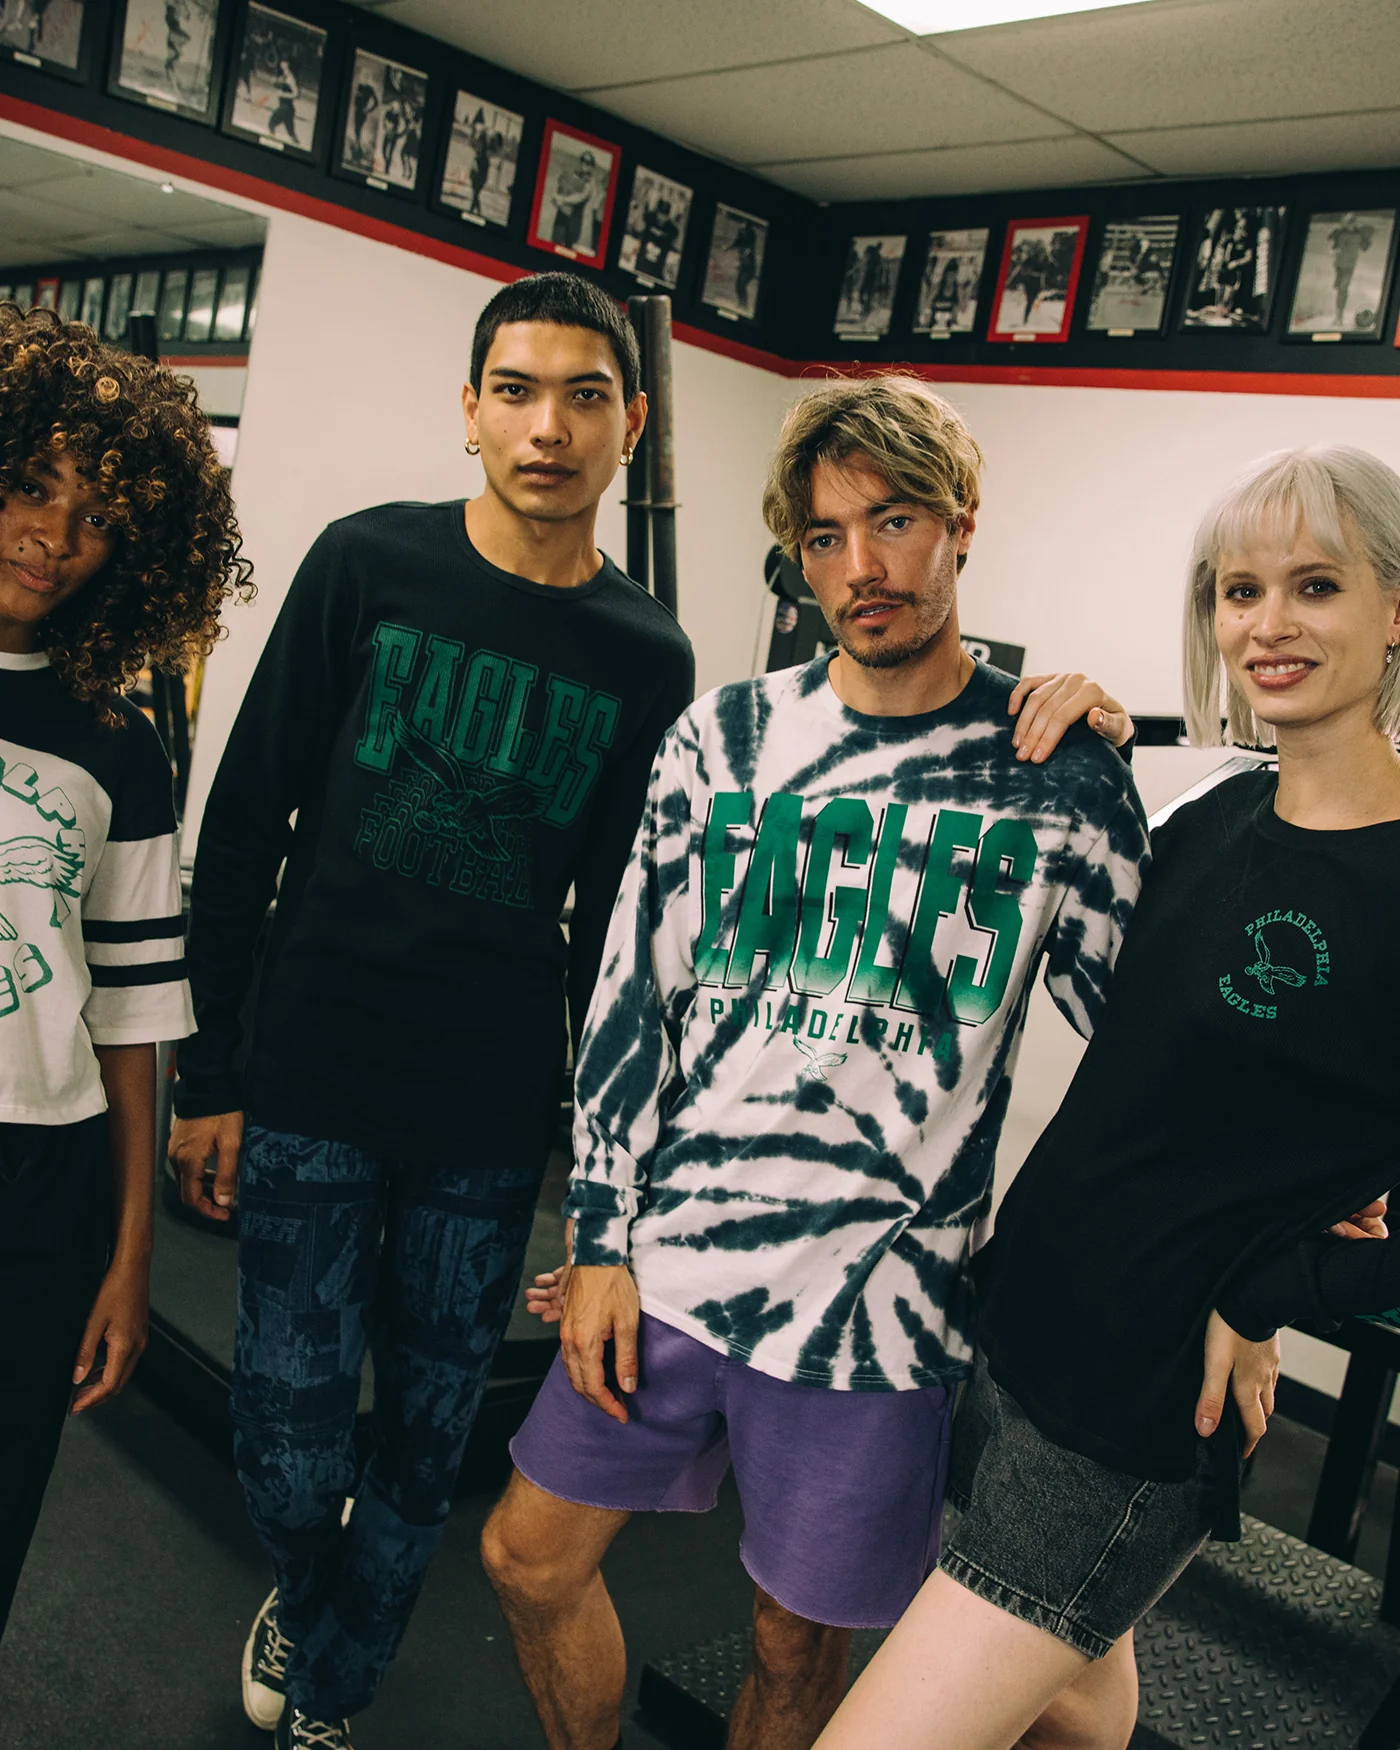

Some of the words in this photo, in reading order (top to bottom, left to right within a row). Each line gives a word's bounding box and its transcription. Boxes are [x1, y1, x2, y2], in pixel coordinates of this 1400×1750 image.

[354, 621, 622, 829] EAGLES
[353, 807, 536, 909] FOOTBAL
[694, 791, 1039, 1028] EAGLES
[1244, 909, 1331, 987] PHILADELPHIA
[709, 997, 953, 1062] PHILADELPHIA
[1219, 974, 1278, 1019] EAGLES
